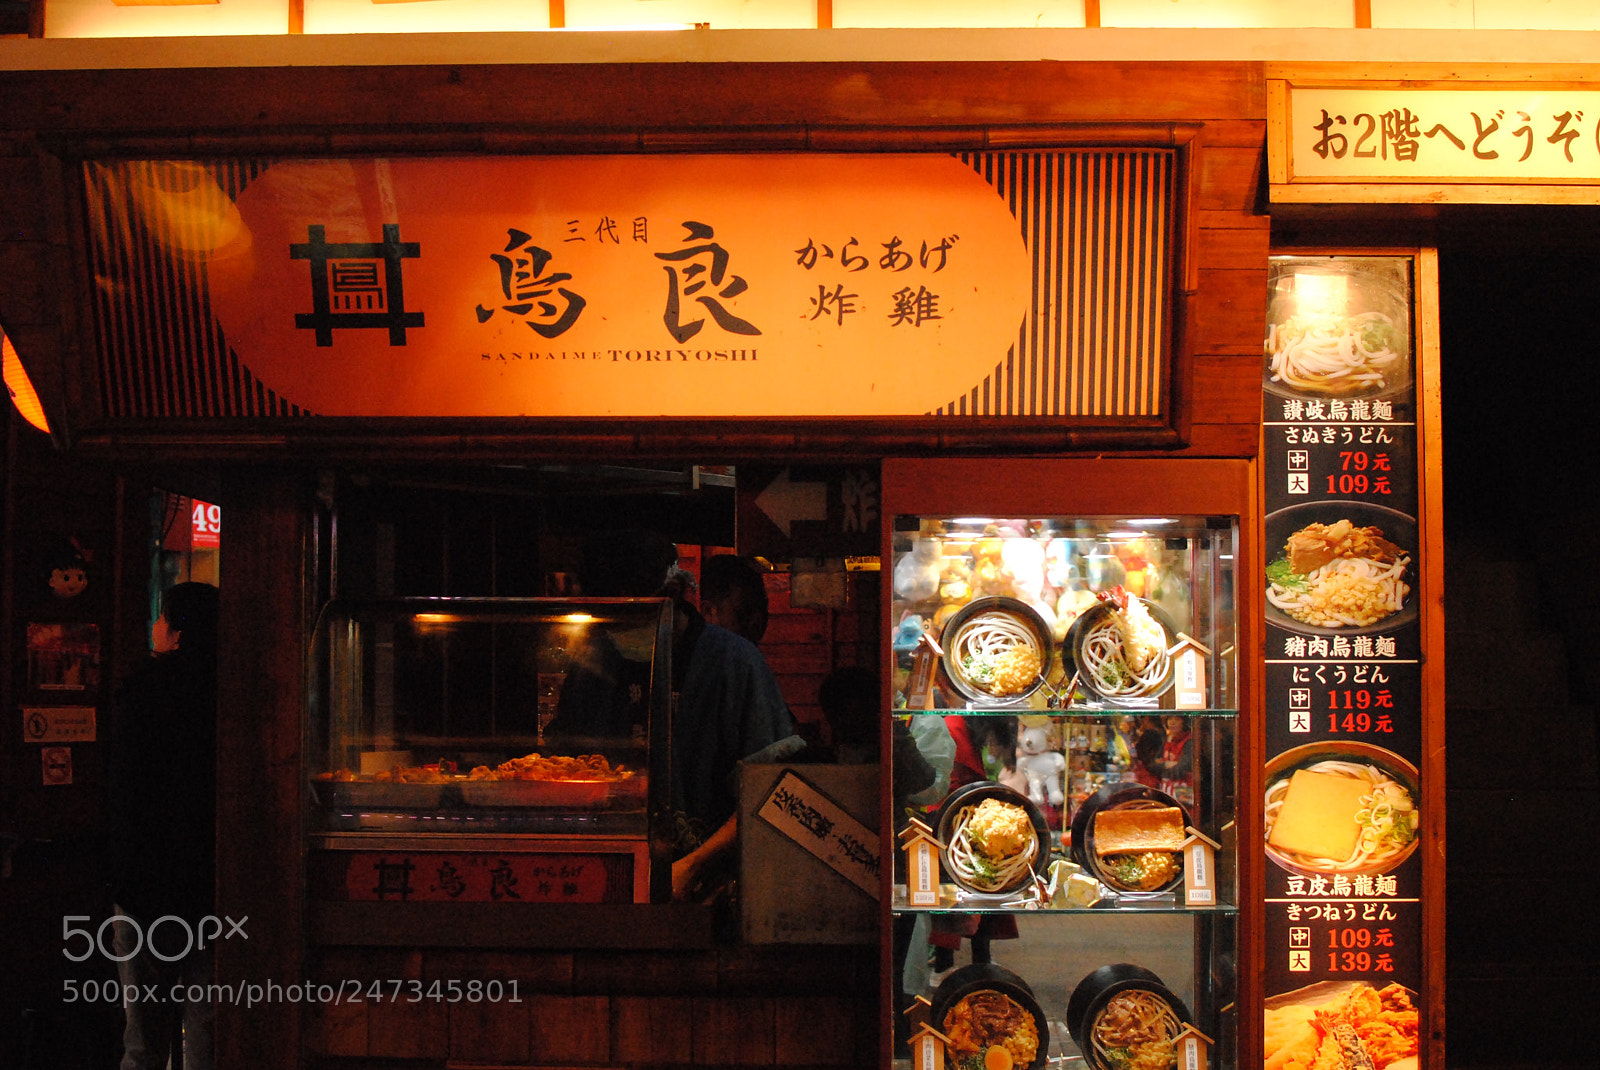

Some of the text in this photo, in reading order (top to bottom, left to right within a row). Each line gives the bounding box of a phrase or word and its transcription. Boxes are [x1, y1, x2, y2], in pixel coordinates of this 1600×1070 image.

[563, 216, 648, 244] 三代目
[794, 234, 960, 273] からあげ
[475, 221, 763, 344] 鳥良
[810, 284, 944, 328] 炸雞
[481, 349, 758, 361] SANDAIME TORIYOSHI
[1284, 426, 1393, 445] さぬきうどん
[1289, 452, 1308, 470] 中
[1289, 475, 1308, 493] 大
[192, 503, 221, 533] 49
[1292, 665, 1390, 684] にくうどん
[1290, 689, 1309, 708] 中
[1289, 713, 1309, 732] 大
[1286, 902, 1397, 921] きつねうどん
[1290, 929, 1309, 947] 中
[1289, 951, 1309, 971] 大
